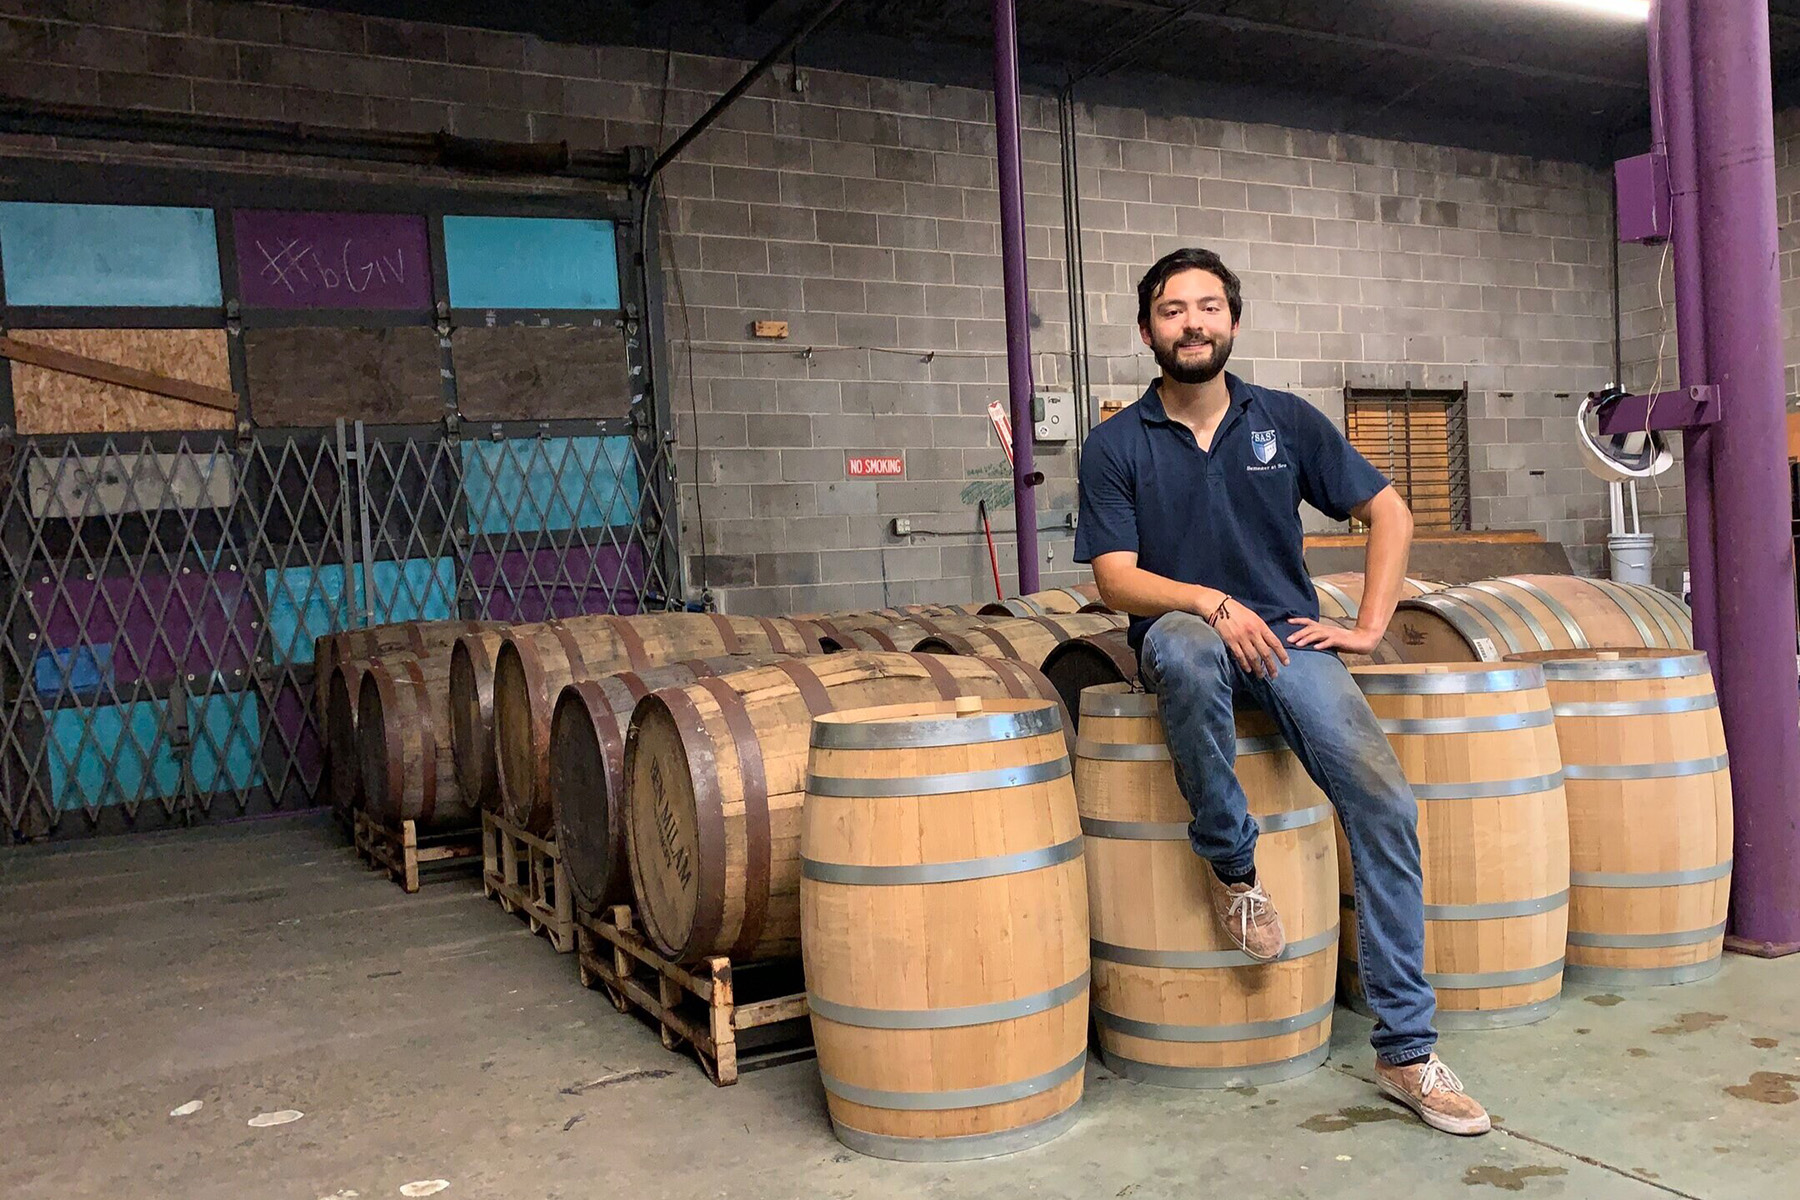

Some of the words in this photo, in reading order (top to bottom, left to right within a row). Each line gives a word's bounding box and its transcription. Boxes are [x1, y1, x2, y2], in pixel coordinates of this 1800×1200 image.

[1254, 432, 1272, 442] SAS
[849, 459, 863, 474] NO
[865, 459, 901, 474] SMOKING
[660, 801, 692, 891] MILAM
